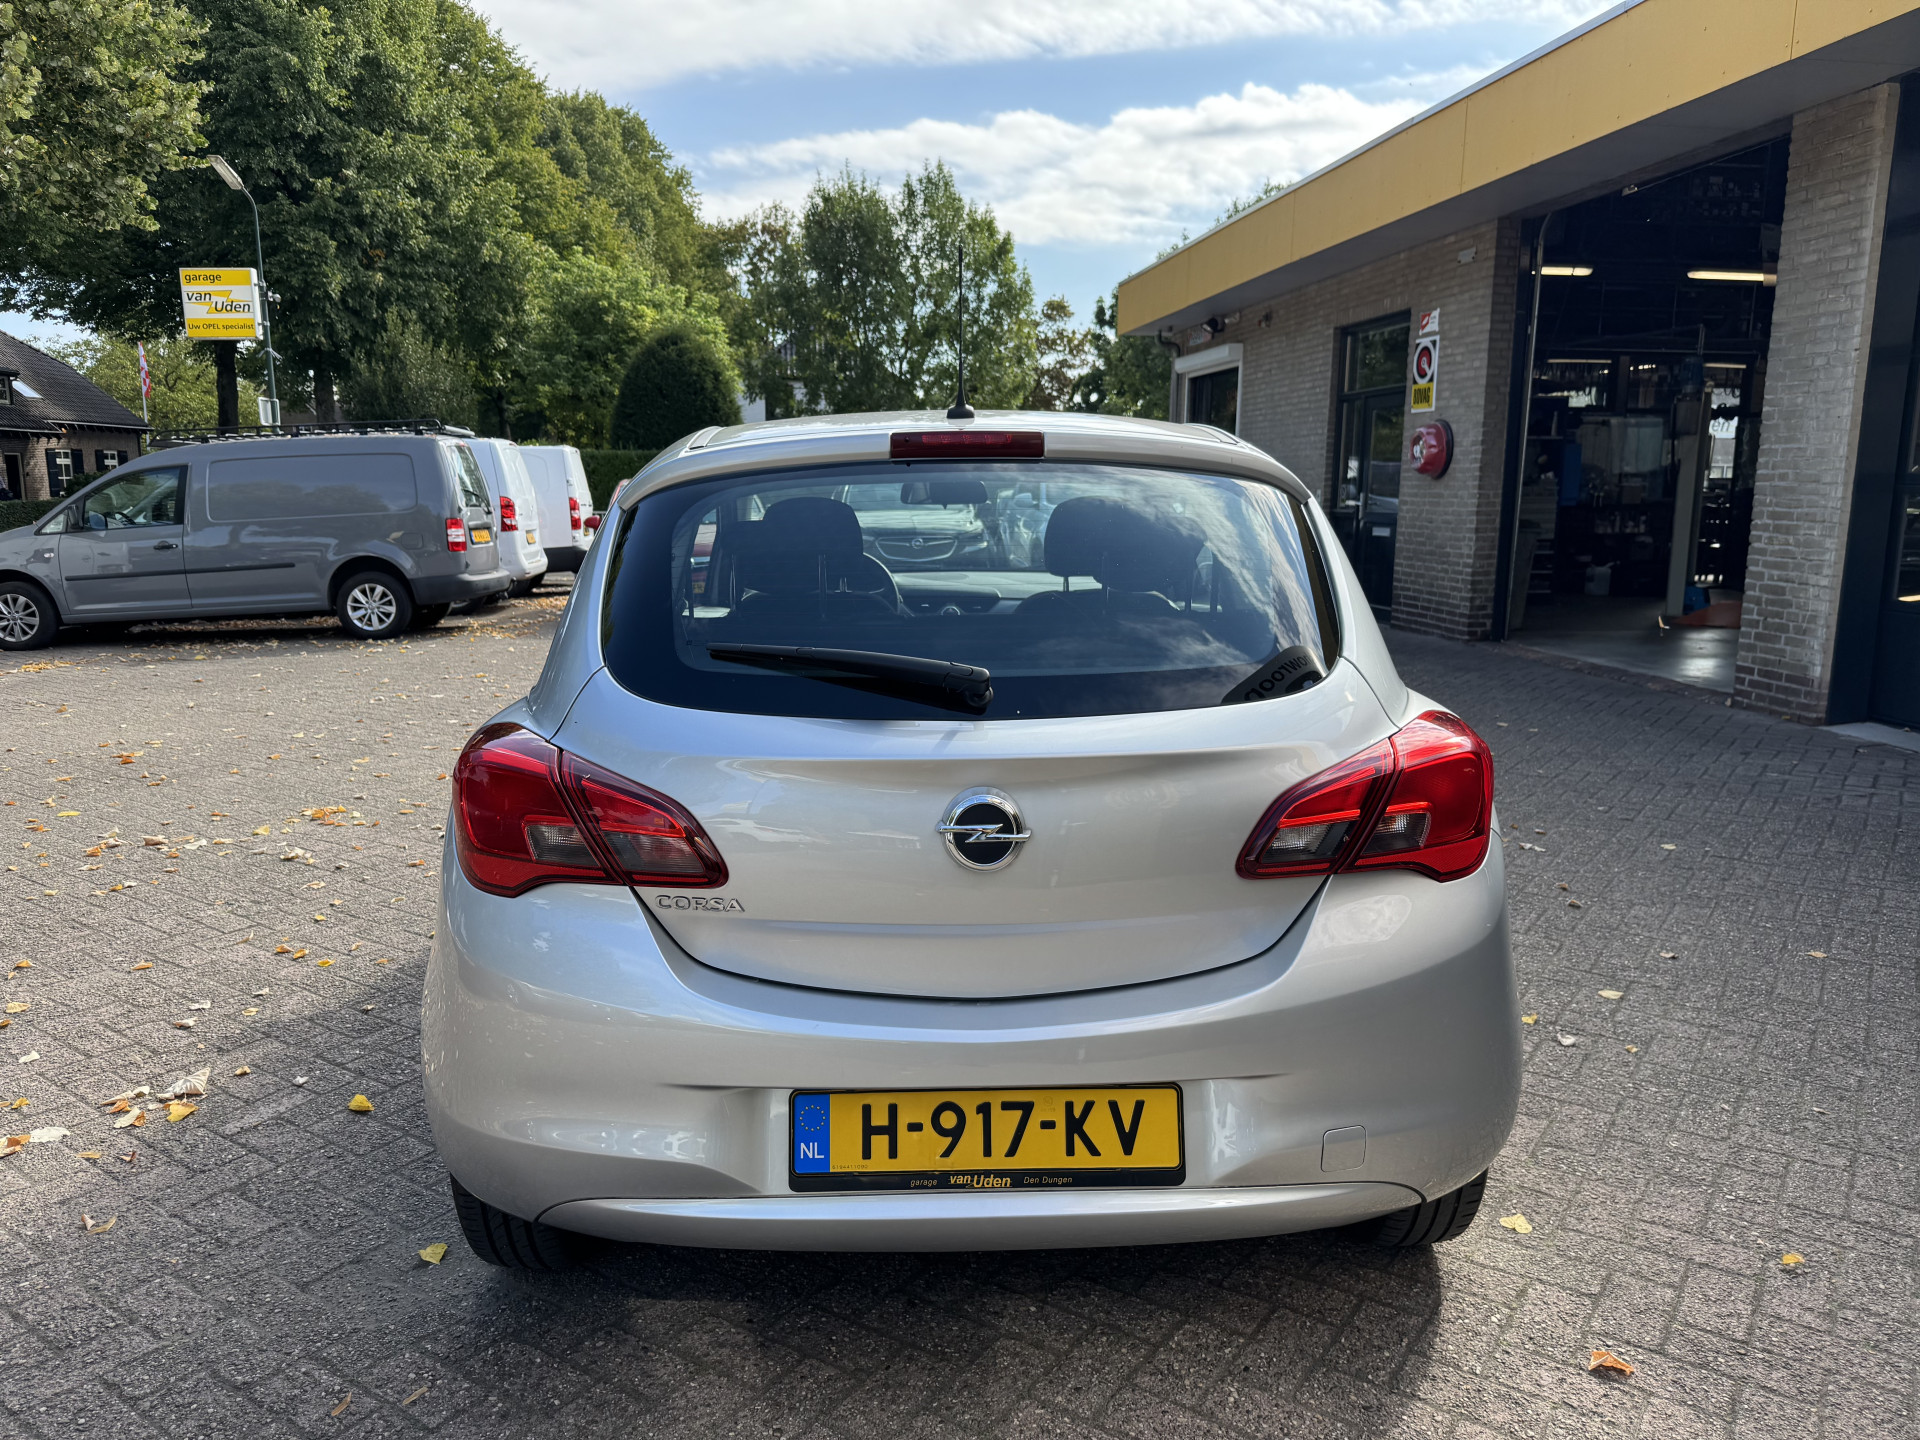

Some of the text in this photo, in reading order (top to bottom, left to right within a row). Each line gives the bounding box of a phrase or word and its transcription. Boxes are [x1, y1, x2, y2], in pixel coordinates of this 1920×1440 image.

[184, 273, 222, 284] garage
[186, 292, 212, 302] van
[214, 301, 251, 313] Uden
[222, 322, 255, 331] specialist
[655, 894, 745, 912] CORSA
[861, 1099, 1146, 1160] H-917-KV
[800, 1142, 825, 1159] NL
[910, 1174, 1073, 1188] garage van Uden Den Dungen
